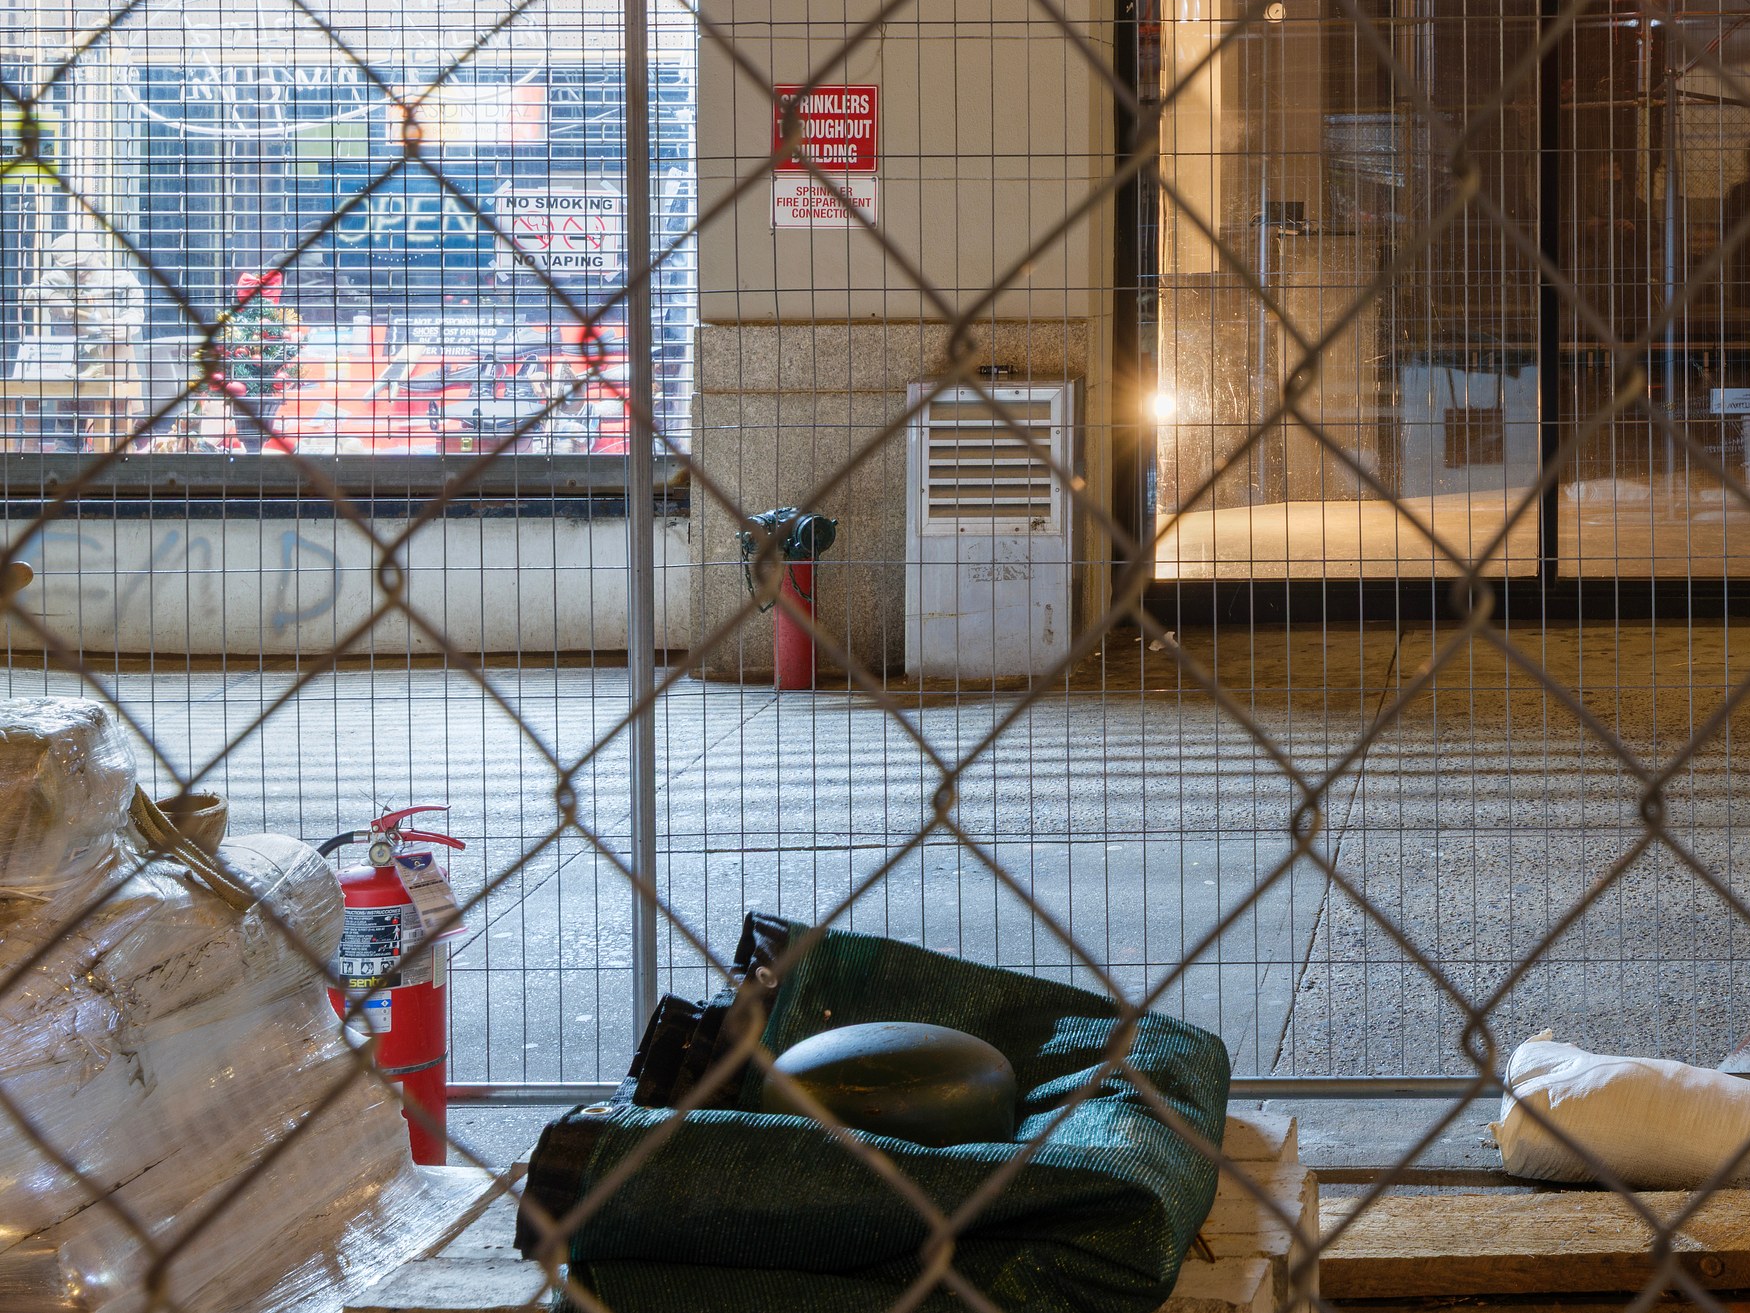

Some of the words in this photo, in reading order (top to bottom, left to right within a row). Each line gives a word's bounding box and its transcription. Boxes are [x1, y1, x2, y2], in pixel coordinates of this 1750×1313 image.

[406, 100, 475, 119] ASON
[776, 118, 873, 139] TROUGHOUT
[795, 186, 853, 197] SPRINKER
[505, 197, 530, 209] NO
[535, 197, 613, 210] SMOKING
[776, 197, 799, 207] FIRE
[802, 197, 872, 208] DEPARTENT
[334, 194, 482, 243] OPEN
[513, 255, 536, 267] NO
[541, 255, 604, 267] VAPING
[412, 326, 439, 336] SHOES
